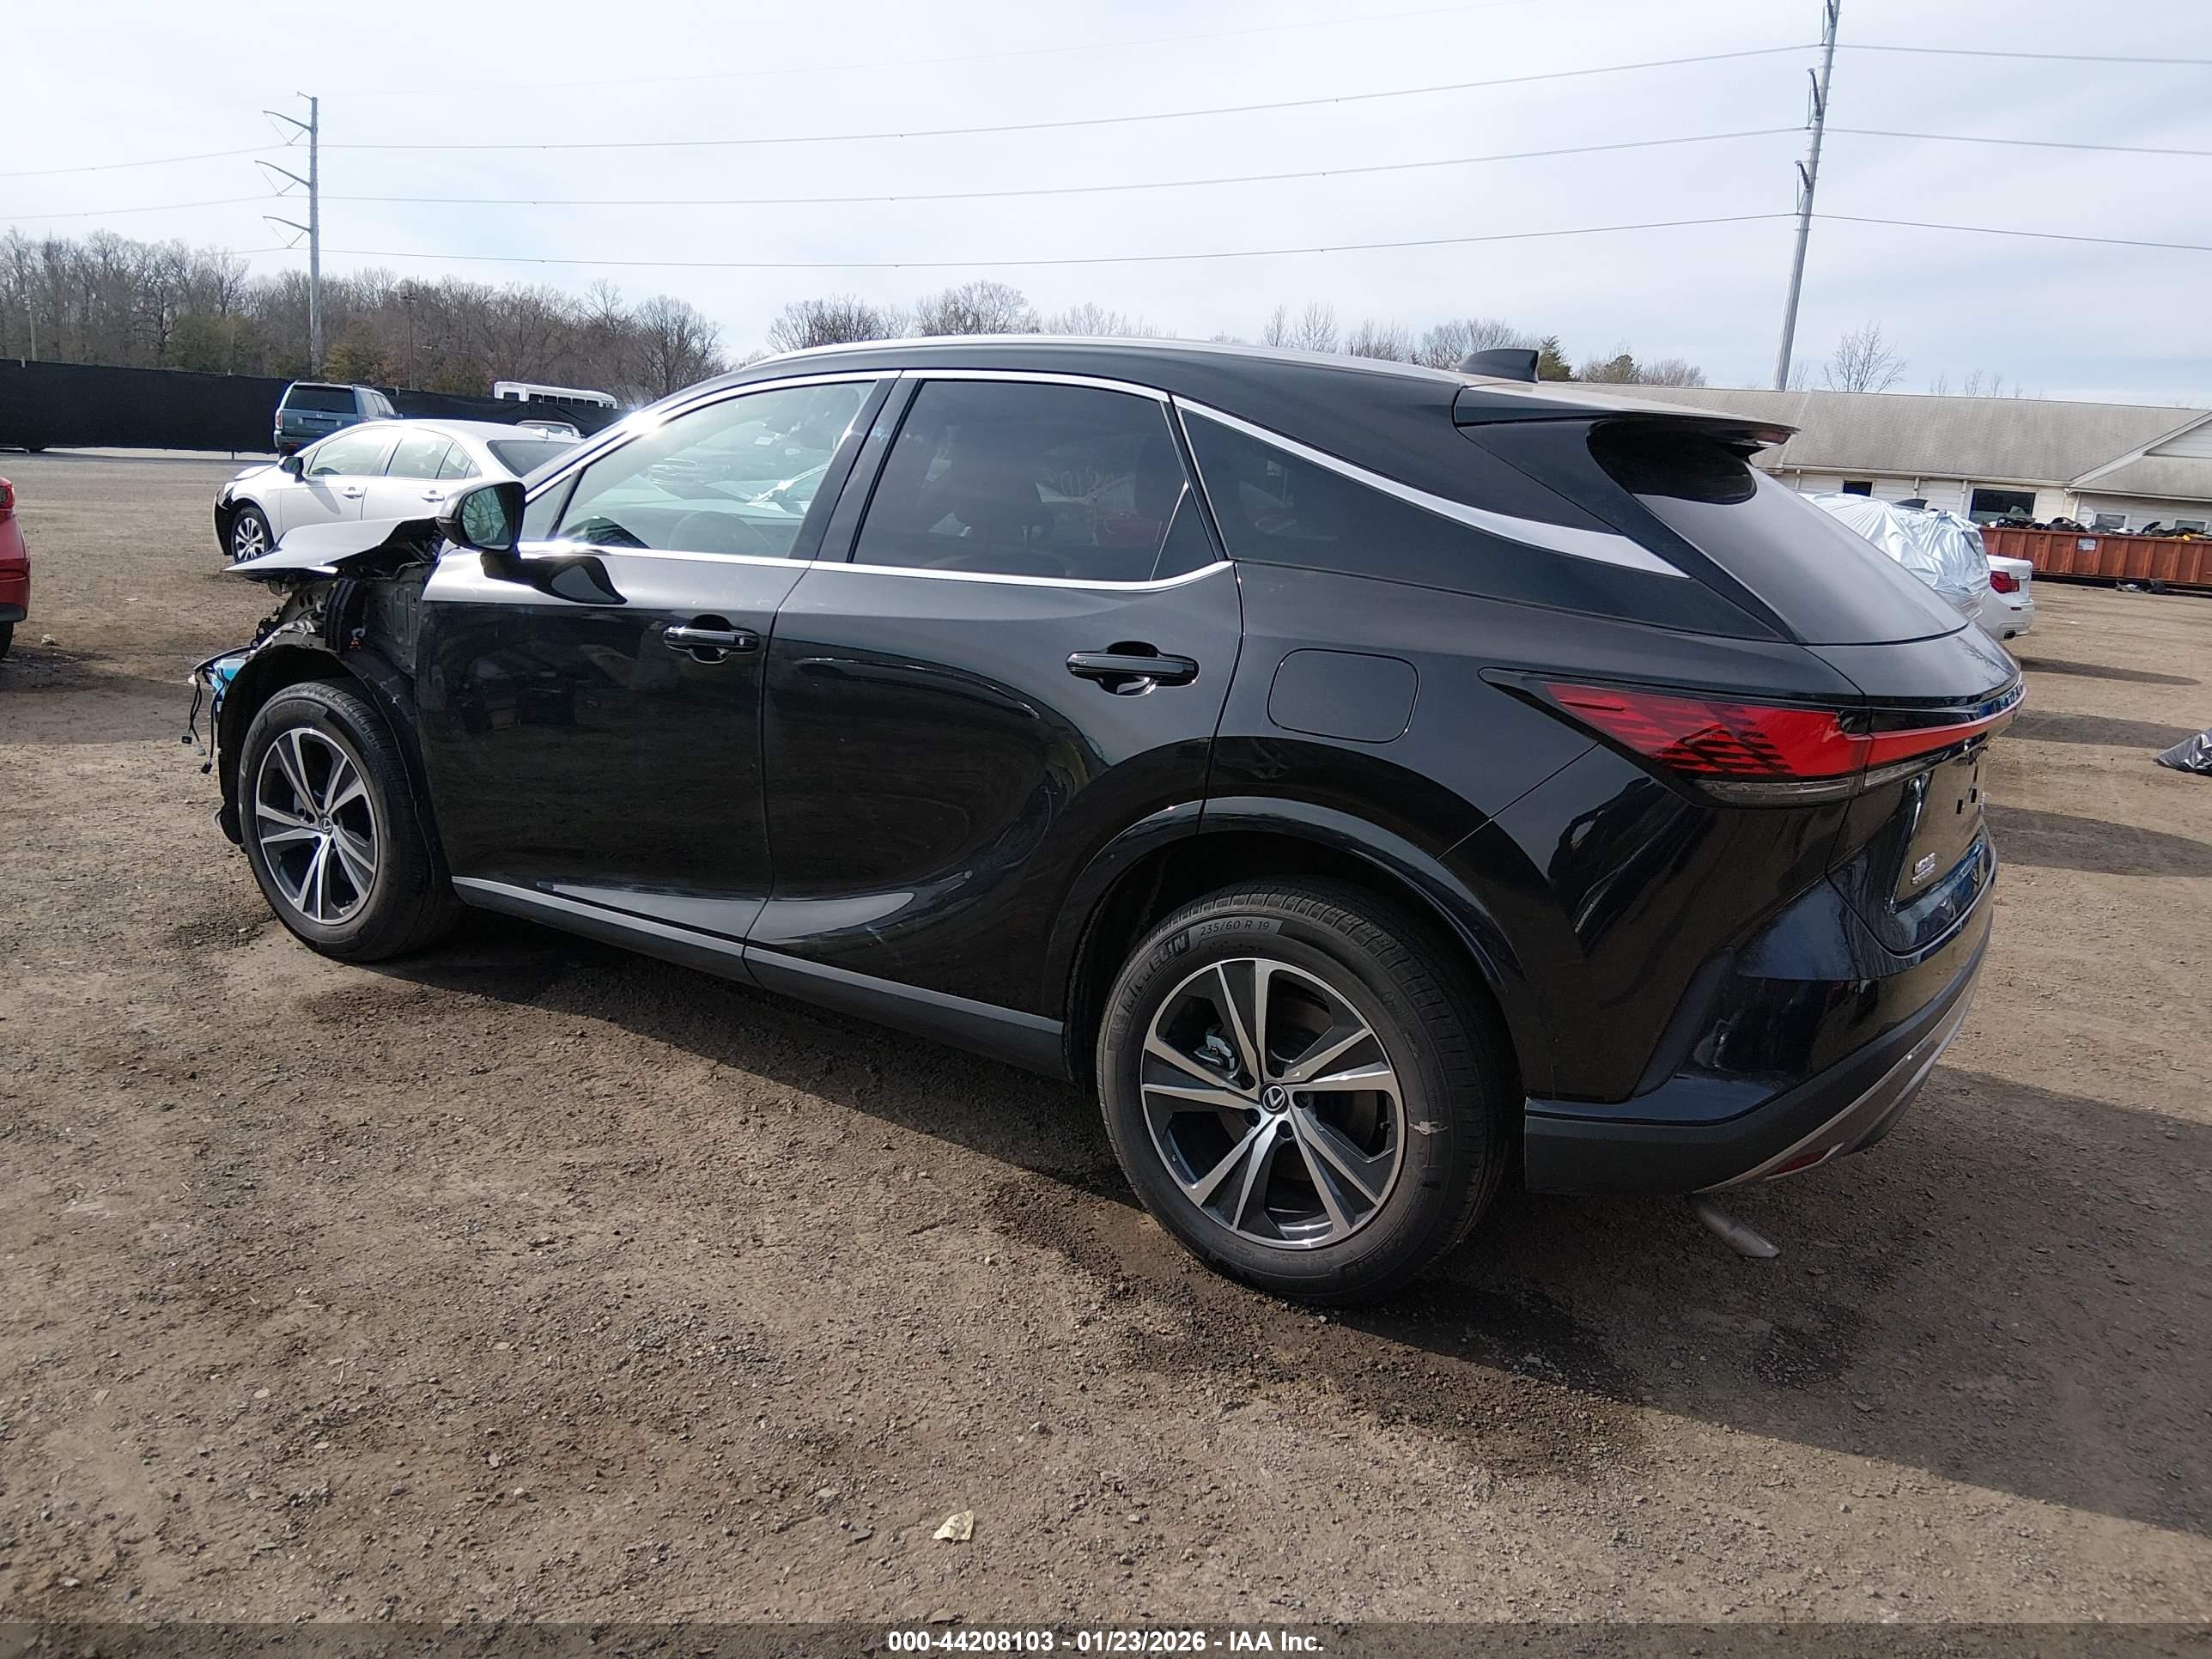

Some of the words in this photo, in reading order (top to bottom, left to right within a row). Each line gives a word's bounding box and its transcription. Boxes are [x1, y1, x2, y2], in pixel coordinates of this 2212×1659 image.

[1200, 920, 1241, 935] 235/60
[1244, 920, 1254, 930] R
[1258, 921, 1270, 931] 19
